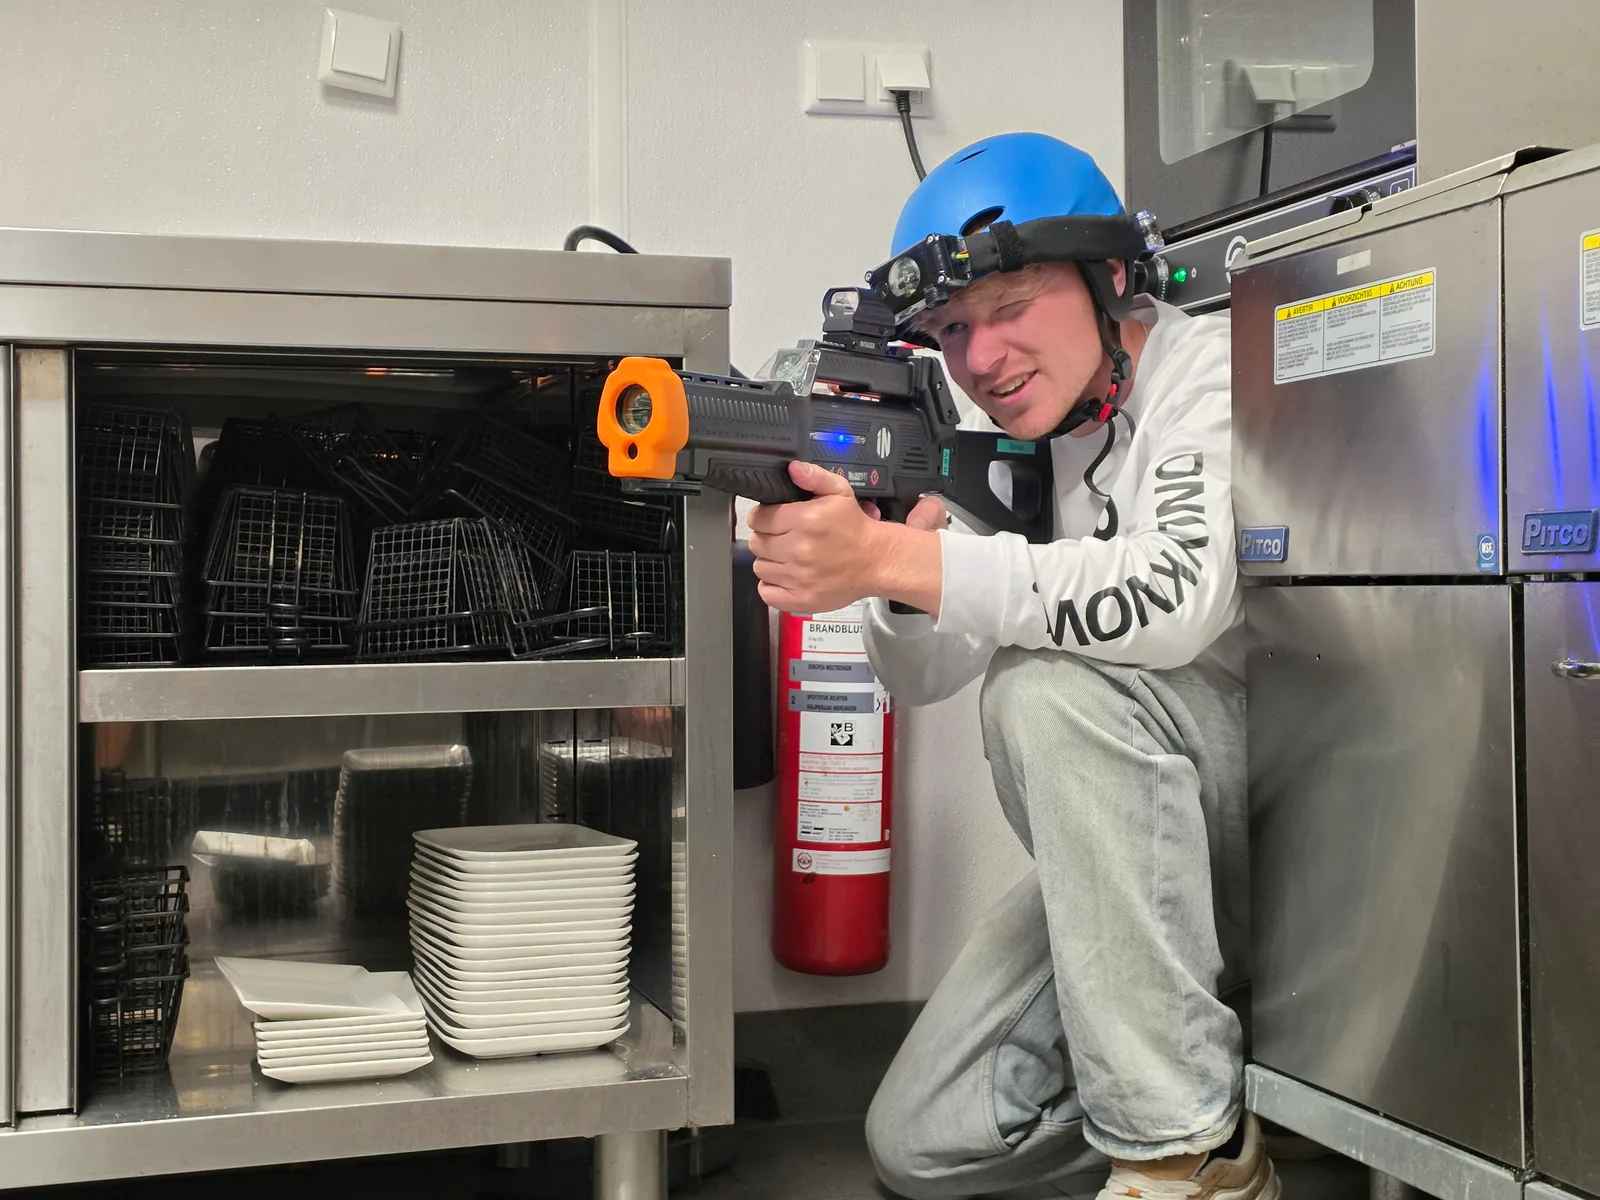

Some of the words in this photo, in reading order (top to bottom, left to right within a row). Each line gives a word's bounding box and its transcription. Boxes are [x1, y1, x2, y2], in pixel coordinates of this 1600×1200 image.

[1395, 276, 1423, 290] ACHTUNG
[1337, 289, 1373, 305] VOORZICHTIG
[1293, 303, 1314, 315] AVERTIR
[790, 695, 796, 705] 2
[844, 722, 854, 732] B
